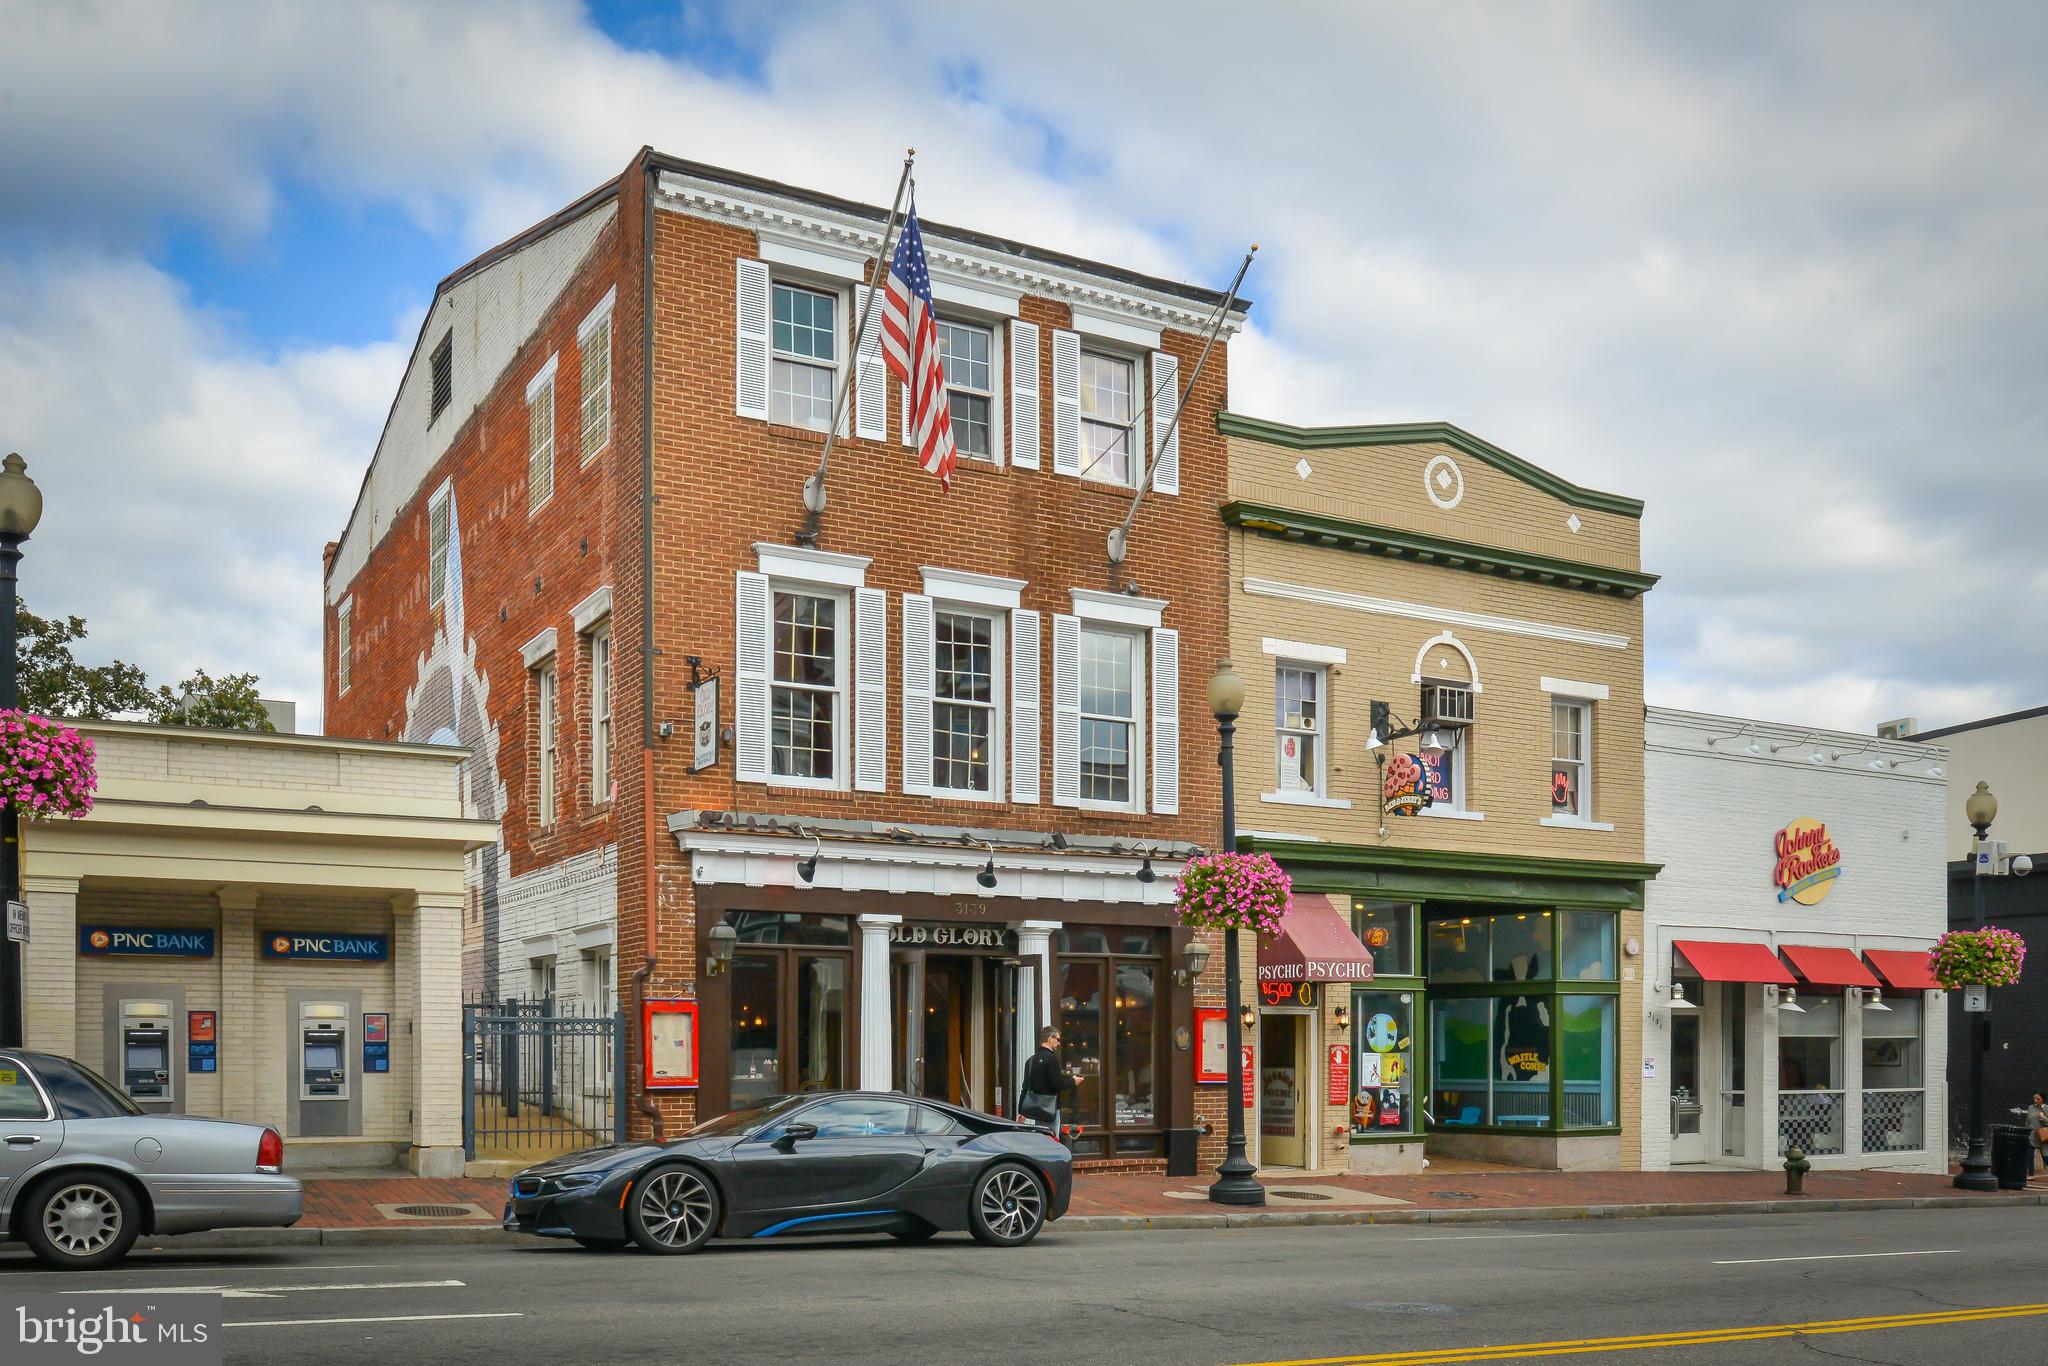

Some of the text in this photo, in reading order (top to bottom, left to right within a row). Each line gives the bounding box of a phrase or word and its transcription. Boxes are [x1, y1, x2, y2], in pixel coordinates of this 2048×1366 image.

[1775, 823, 1826, 858] Johnny
[1774, 839, 1841, 888] Rockets
[955, 902, 986, 915] 3139
[112, 932, 205, 950] PNC BANK
[933, 927, 1008, 946] GLORY
[292, 938, 379, 954] PNC BANK
[1258, 963, 1304, 980] PSYCHIC
[1307, 961, 1372, 979] PSYCHIC
[1507, 1052, 1539, 1066] WAFFLE
[1263, 1088, 1292, 1098] PSYCHIC
